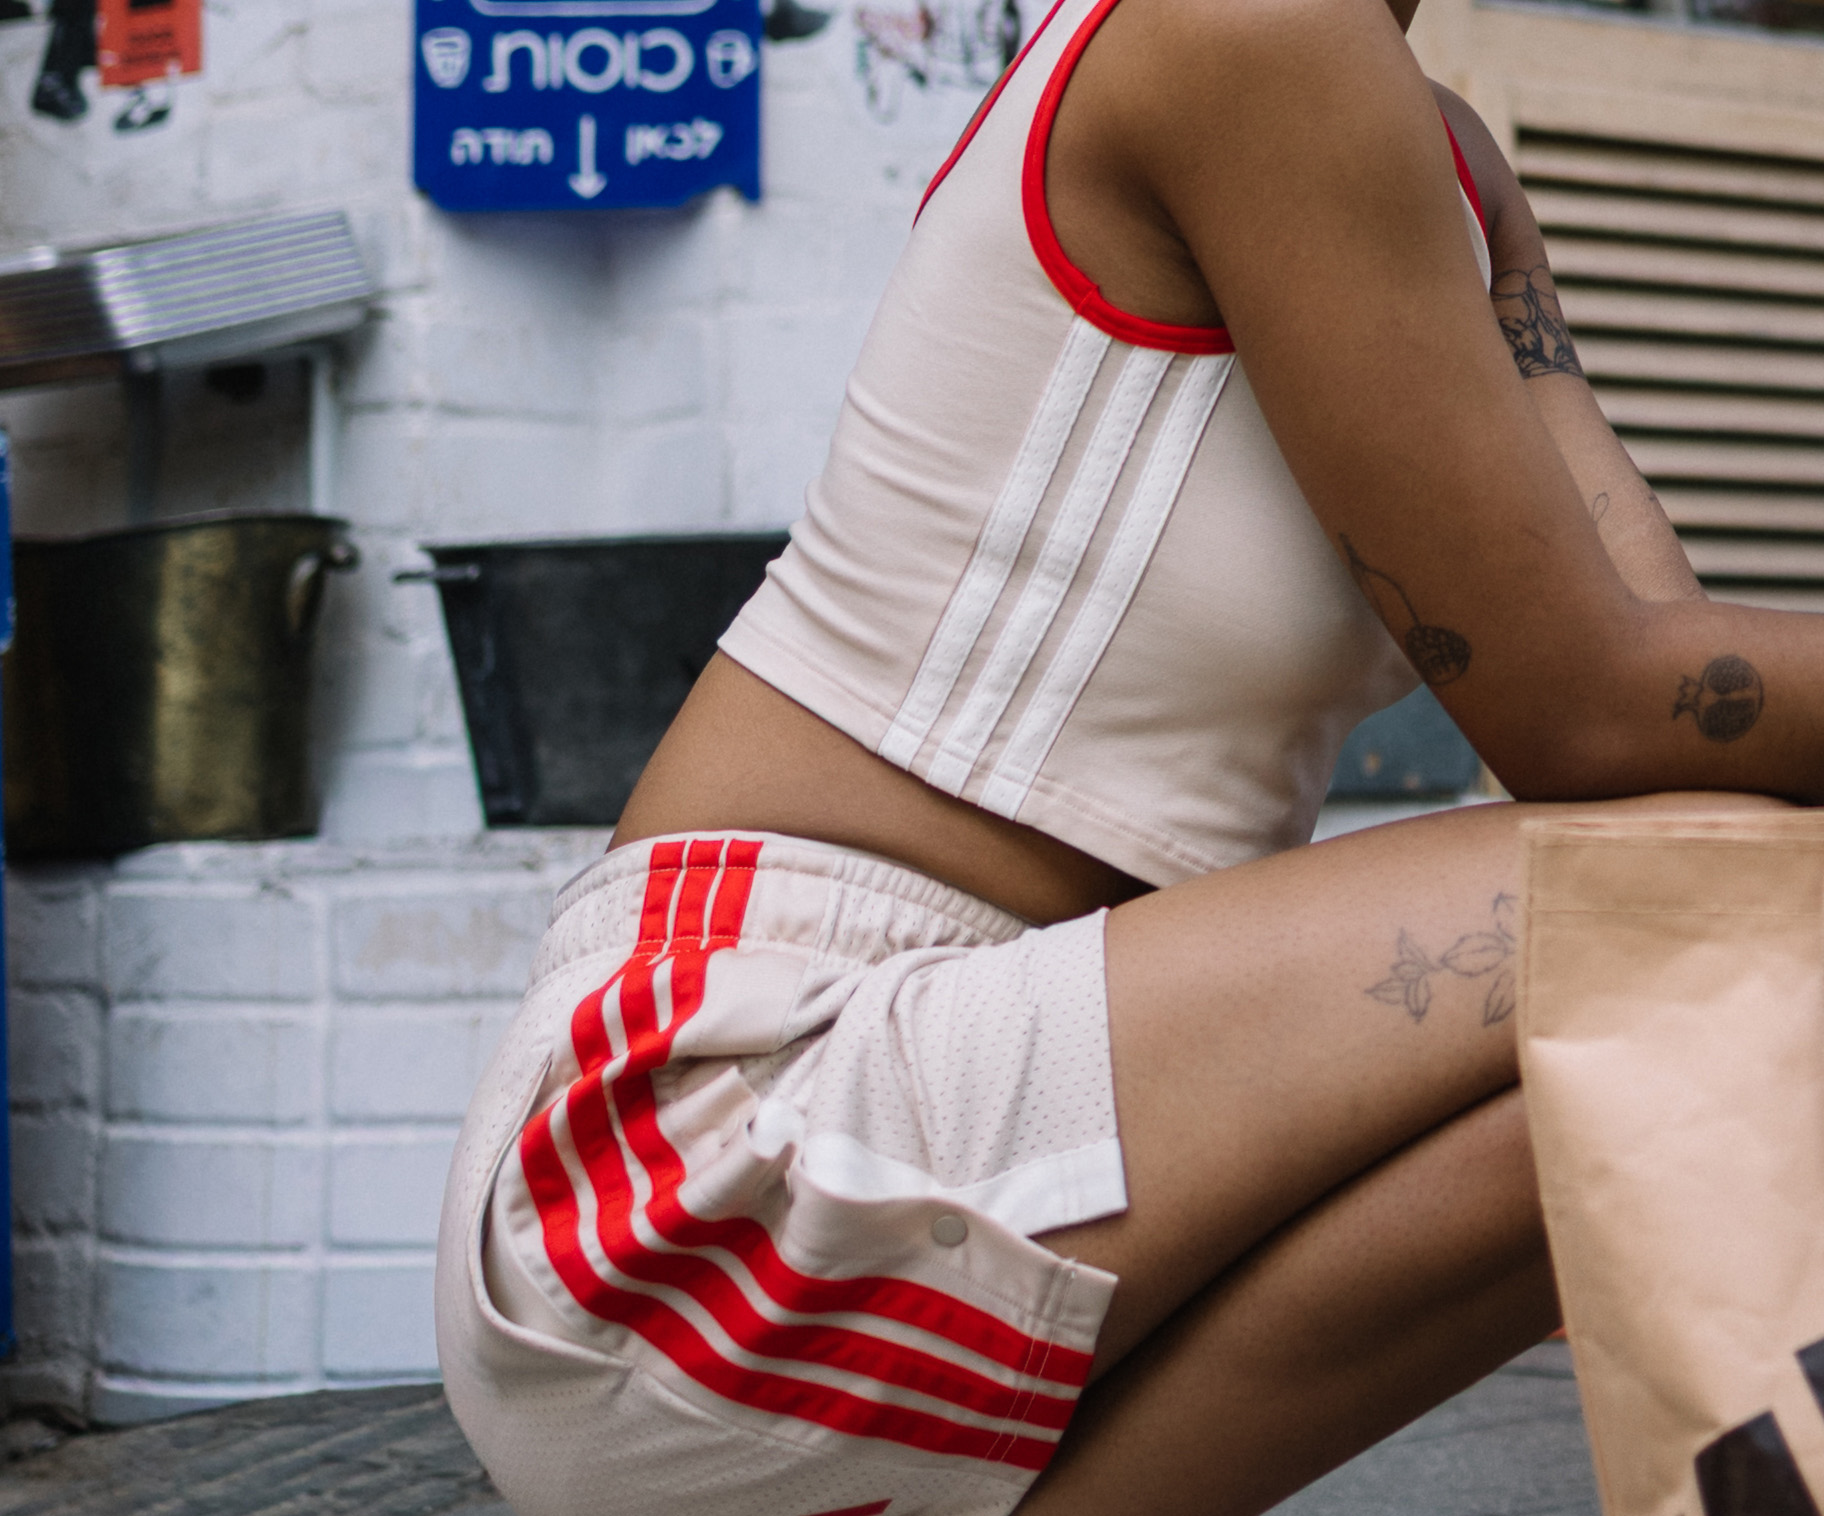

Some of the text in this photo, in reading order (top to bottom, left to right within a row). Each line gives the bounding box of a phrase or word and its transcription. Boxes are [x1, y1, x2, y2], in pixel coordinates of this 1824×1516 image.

[482, 28, 696, 94] כוסות
[450, 116, 724, 167] לכאן תודה
